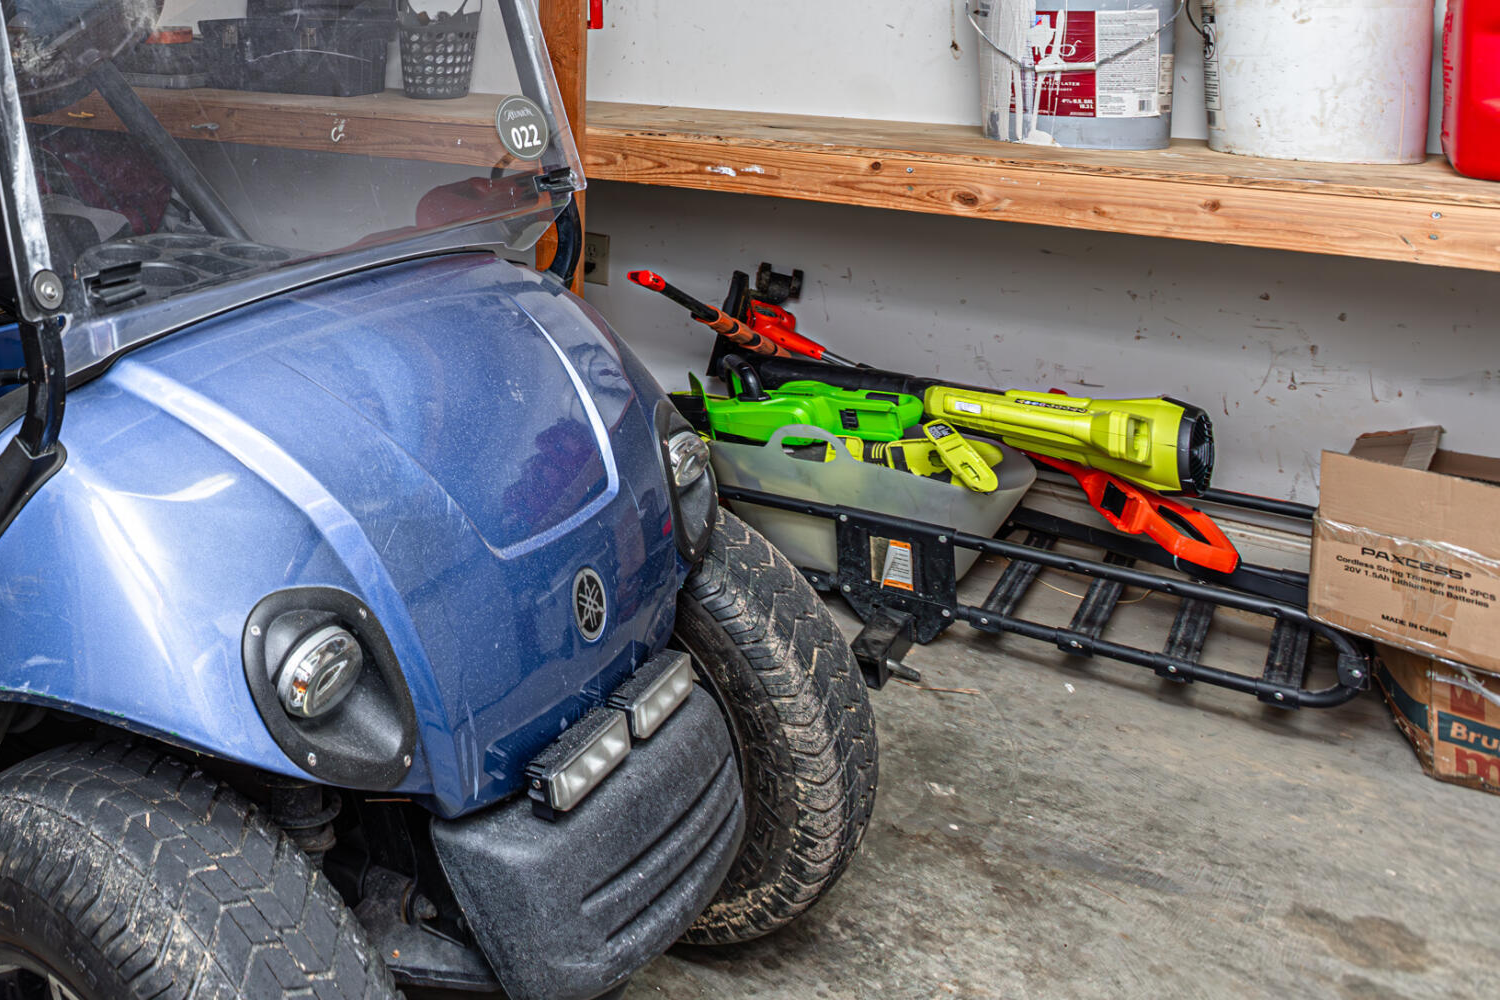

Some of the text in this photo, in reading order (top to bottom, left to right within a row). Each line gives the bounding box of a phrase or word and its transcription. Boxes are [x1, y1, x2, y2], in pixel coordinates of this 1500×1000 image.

[511, 123, 542, 150] 022
[1336, 554, 1496, 602] Cordless String Trimmer with 2PCS
[1344, 564, 1489, 608] 20V 1.5Ah Lithium-Ion Batteries
[1381, 614, 1448, 638] MADE IN CHINA
[1450, 720, 1500, 751] Bru
